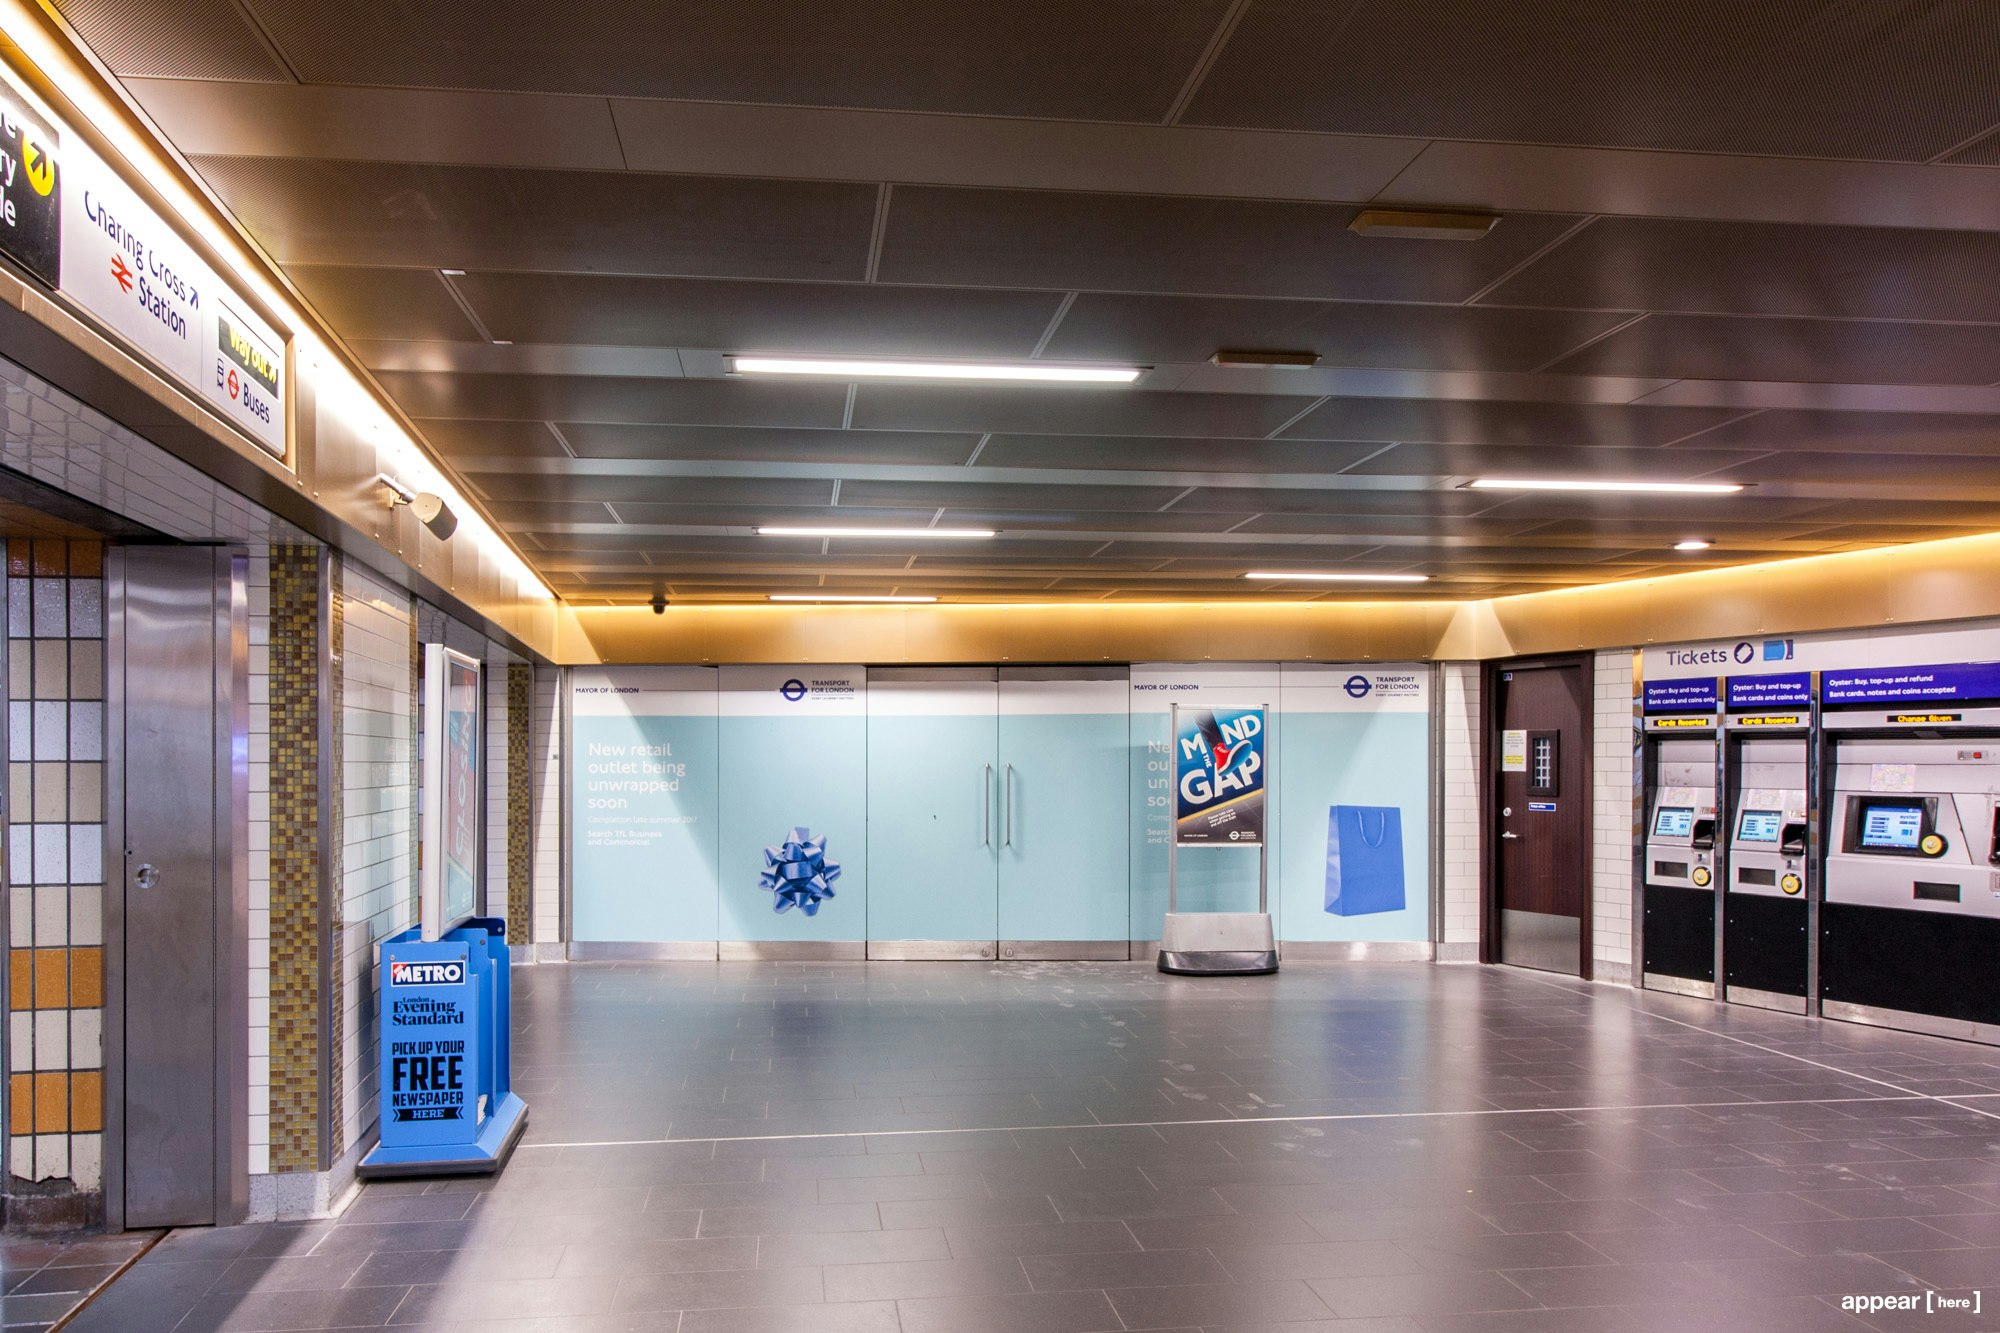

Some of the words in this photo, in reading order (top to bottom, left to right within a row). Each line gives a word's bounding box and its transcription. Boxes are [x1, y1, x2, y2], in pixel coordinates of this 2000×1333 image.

[84, 190, 143, 271] Charing
[149, 250, 186, 302] Cross
[138, 276, 186, 340] Station
[229, 326, 251, 367] Way
[251, 350, 270, 379] out
[243, 382, 270, 424] Buses
[1666, 649, 1727, 666] Tickets
[1733, 683, 1755, 692] Oyster:
[1755, 683, 1766, 691] Buy
[1780, 682, 1801, 690] top-up
[1829, 679, 1853, 687] Oyster:
[1870, 677, 1893, 685] top-up
[1648, 688, 1668, 696] Oyster:
[1668, 687, 1679, 695] Buy
[1690, 686, 1709, 694] top-up
[1794, 693, 1808, 702] only
[1922, 686, 1956, 694] accepted
[1703, 696, 1716, 704] only
[1657, 719, 1676, 727] Cards
[1677, 718, 1707, 726] Accepted
[1742, 717, 1763, 725] Cards
[1764, 716, 1797, 725] Accepted
[1928, 714, 1952, 722] Given
[588, 743, 626, 756] New
[631, 743, 672, 756] retail
[1148, 740, 1170, 753] Ne
[588, 761, 638, 774] outlet
[642, 760, 686, 777] being
[1203, 753, 1213, 769] THE
[1180, 751, 1261, 804] GAP
[588, 778, 680, 795] unwrapped
[588, 798, 627, 809] soon
[587, 838, 602, 846] and
[603, 838, 650, 846] Commercial
[395, 964, 461, 983] METRO
[393, 999, 456, 1015] Evening
[392, 1011, 464, 1026] Standard
[392, 1041, 416, 1055] PICK
[418, 1041, 433, 1054] UP
[435, 1040, 465, 1054] YOUR
[392, 1055, 464, 1092] FREE
[392, 1091, 464, 1106] NEWSPAPER
[412, 1108, 446, 1119] HERE
